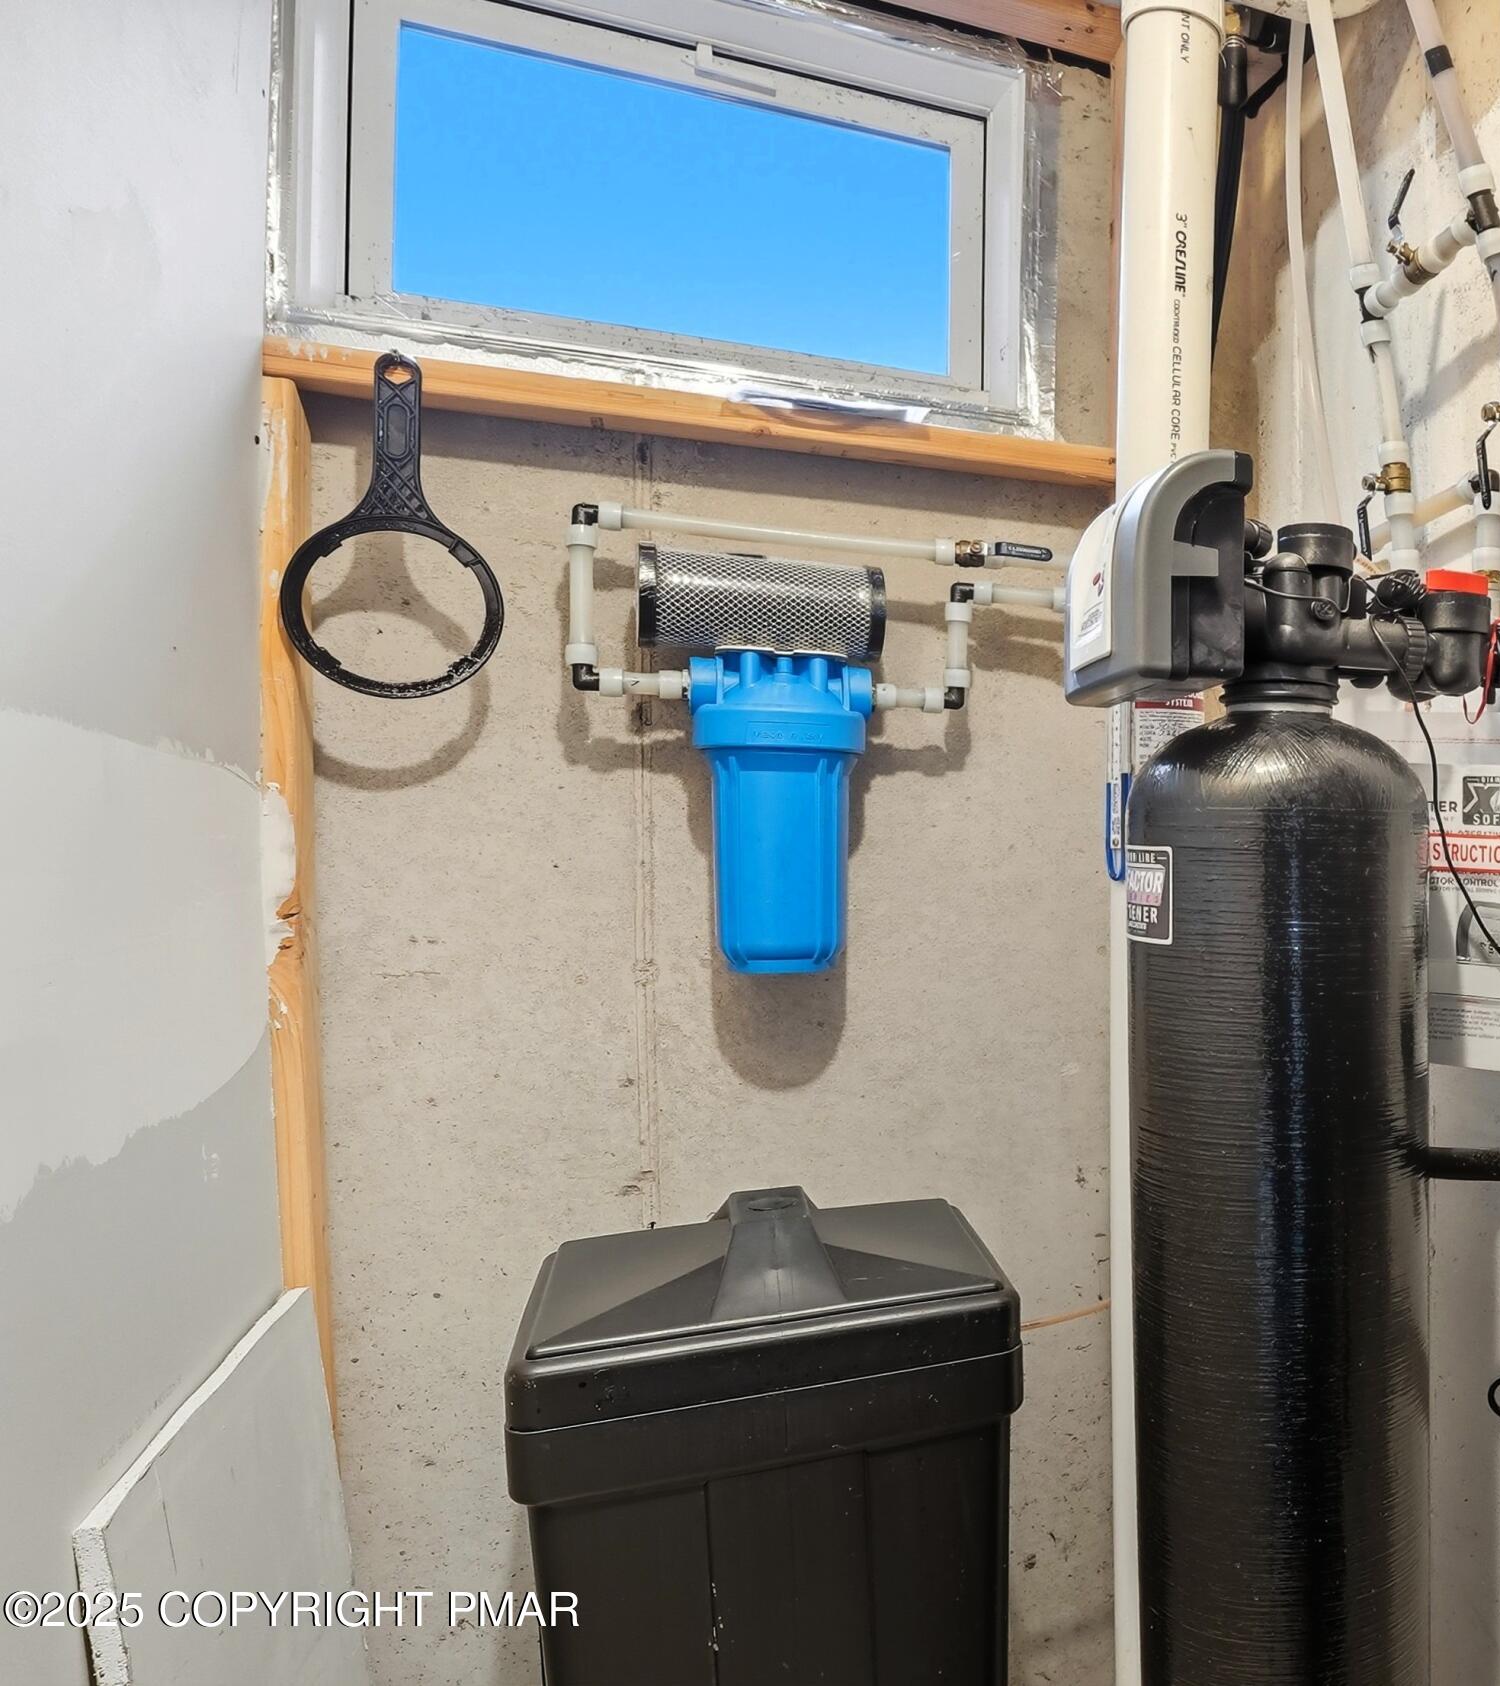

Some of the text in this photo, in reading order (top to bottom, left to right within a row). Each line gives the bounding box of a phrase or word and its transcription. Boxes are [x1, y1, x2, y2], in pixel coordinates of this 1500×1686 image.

[1180, 10, 1191, 64] NT ONLY
[1171, 345, 1182, 406] CELLULAR
[1170, 410, 1181, 440] CORE
[1458, 878, 1499, 887] ONTROL
